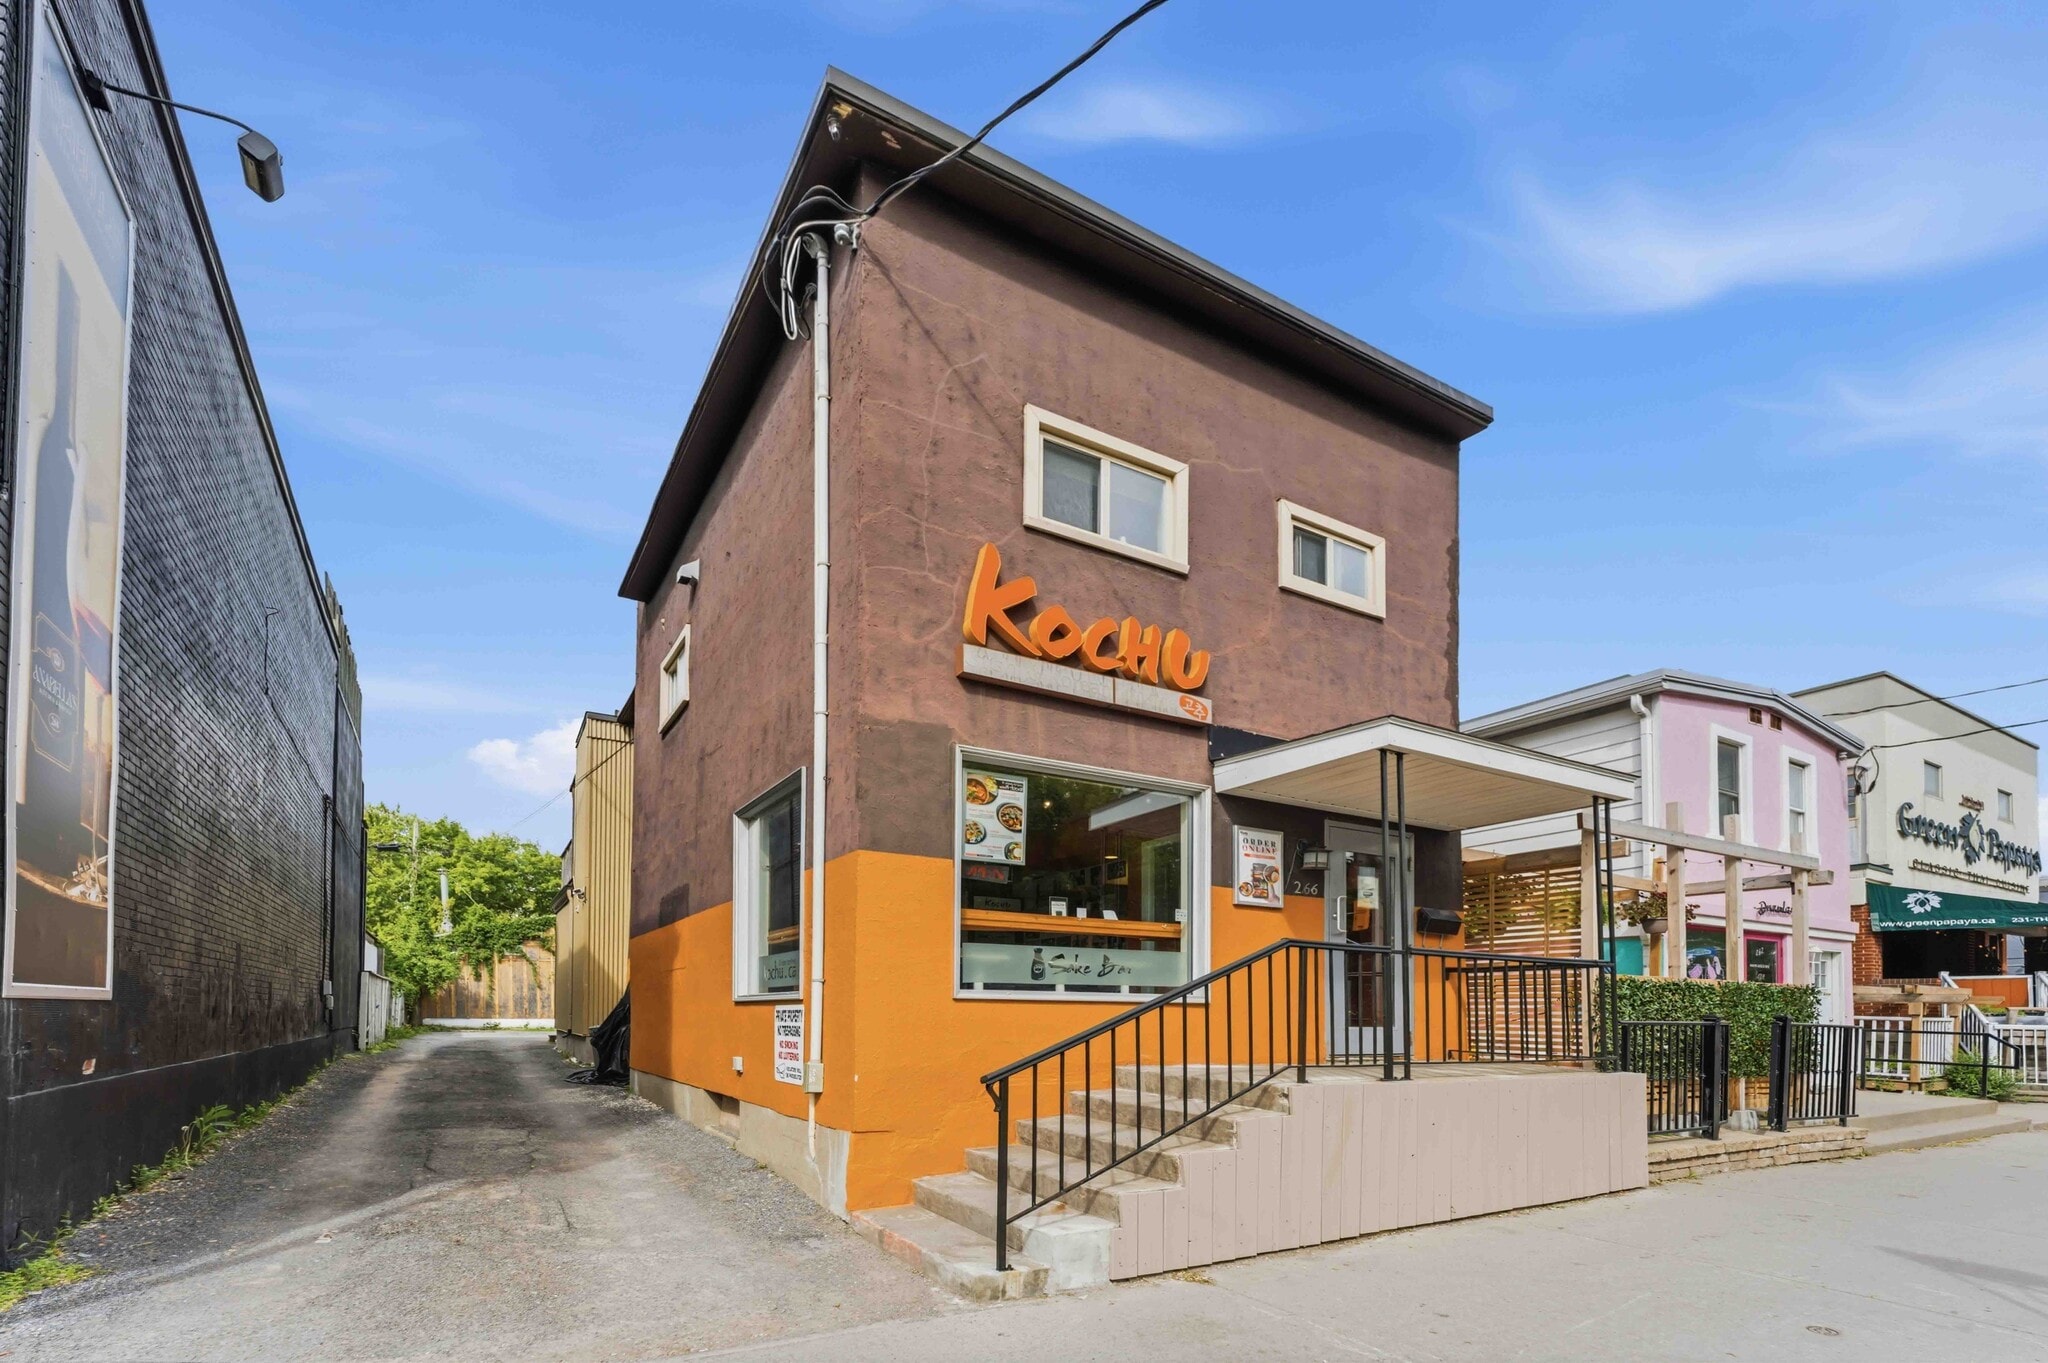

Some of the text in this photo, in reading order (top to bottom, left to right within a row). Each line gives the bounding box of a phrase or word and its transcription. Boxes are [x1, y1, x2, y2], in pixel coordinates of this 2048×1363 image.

[1243, 837, 1277, 848] ORDER
[1242, 844, 1278, 855] ONLINE
[1294, 880, 1318, 895] 266
[1879, 917, 1996, 929] www.greenpapaya.ca
[1048, 953, 1091, 976] Sake
